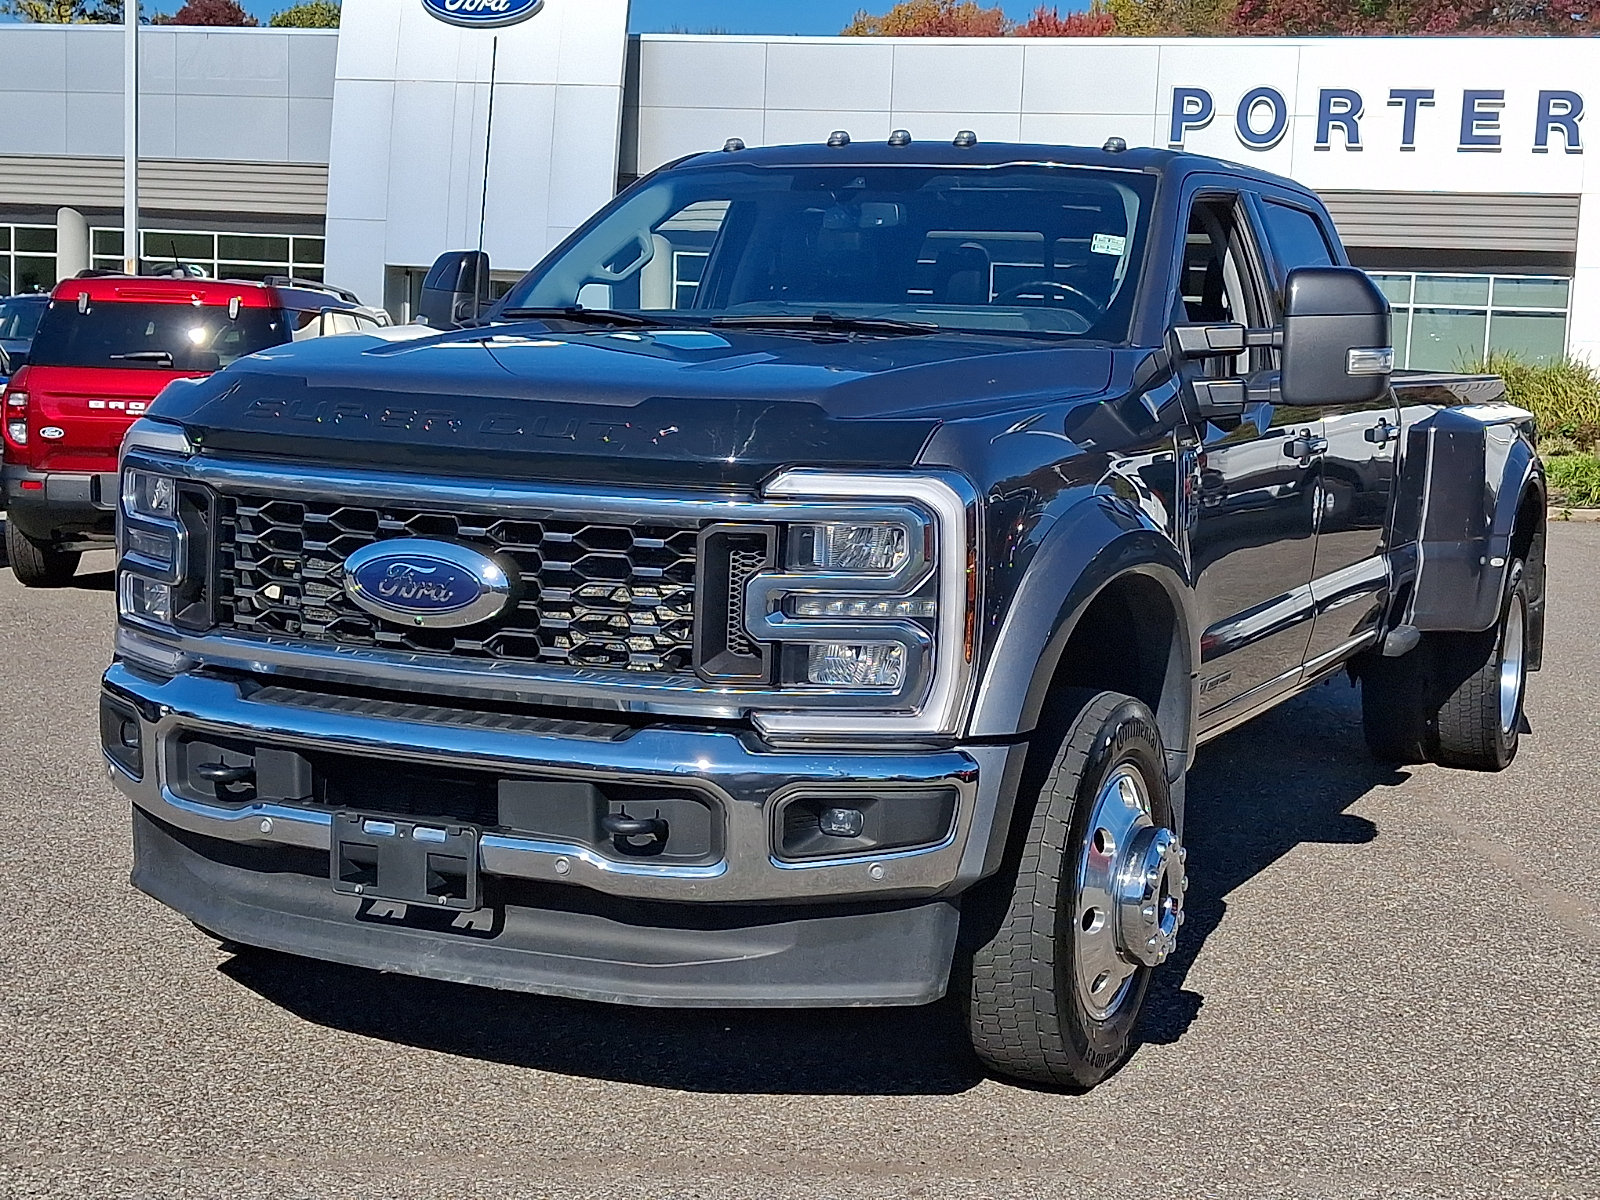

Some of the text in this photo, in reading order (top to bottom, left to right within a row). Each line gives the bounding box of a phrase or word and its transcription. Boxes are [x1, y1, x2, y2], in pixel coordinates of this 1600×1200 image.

[1168, 84, 1586, 154] PORTER
[243, 396, 464, 433] SUPER
[378, 562, 456, 602] Ford
